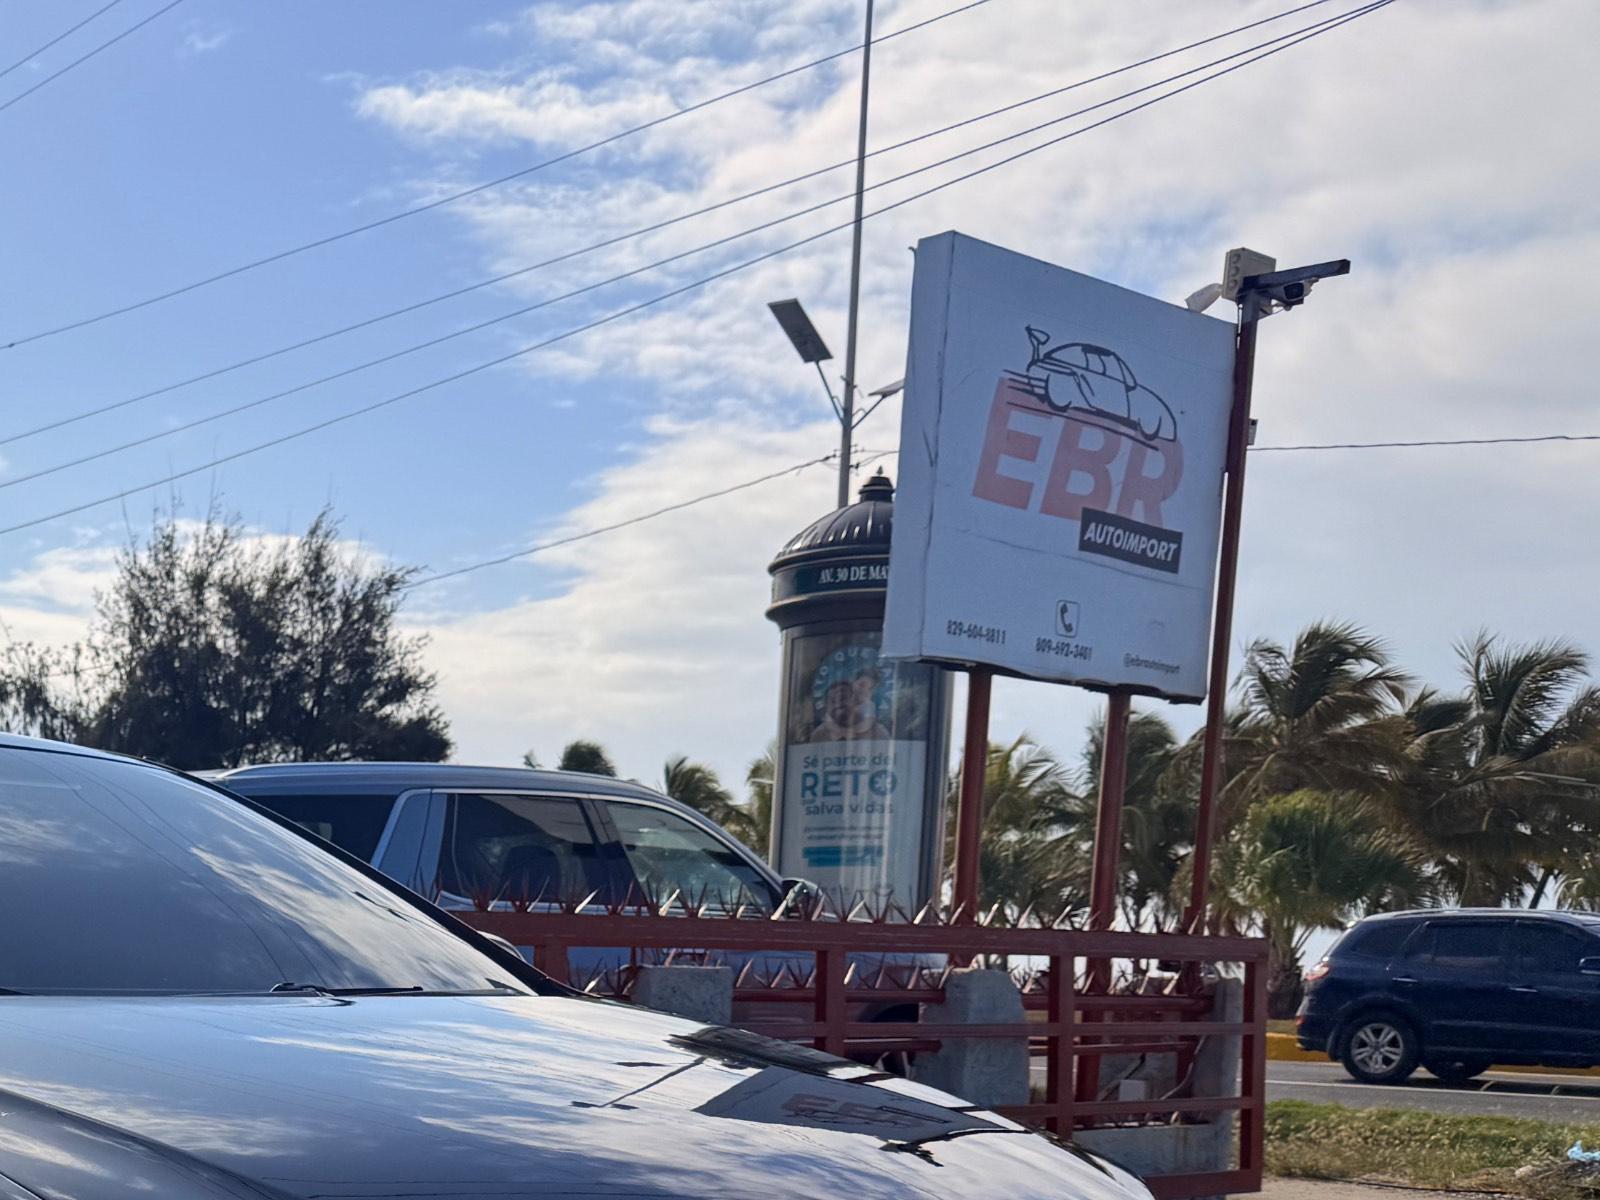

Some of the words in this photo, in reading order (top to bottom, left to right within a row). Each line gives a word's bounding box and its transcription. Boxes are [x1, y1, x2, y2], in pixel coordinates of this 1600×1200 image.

[972, 377, 1185, 528] EBR
[1083, 521, 1178, 562] AUTOIMPORT
[835, 568, 849, 583] 30
[850, 566, 868, 581] DE
[868, 565, 889, 580] MA
[803, 753, 818, 769] Sé
[822, 754, 867, 770] parte
[871, 752, 897, 766] del
[801, 769, 898, 798] RETO
[805, 802, 844, 815] salva
[849, 801, 894, 815] vidas
